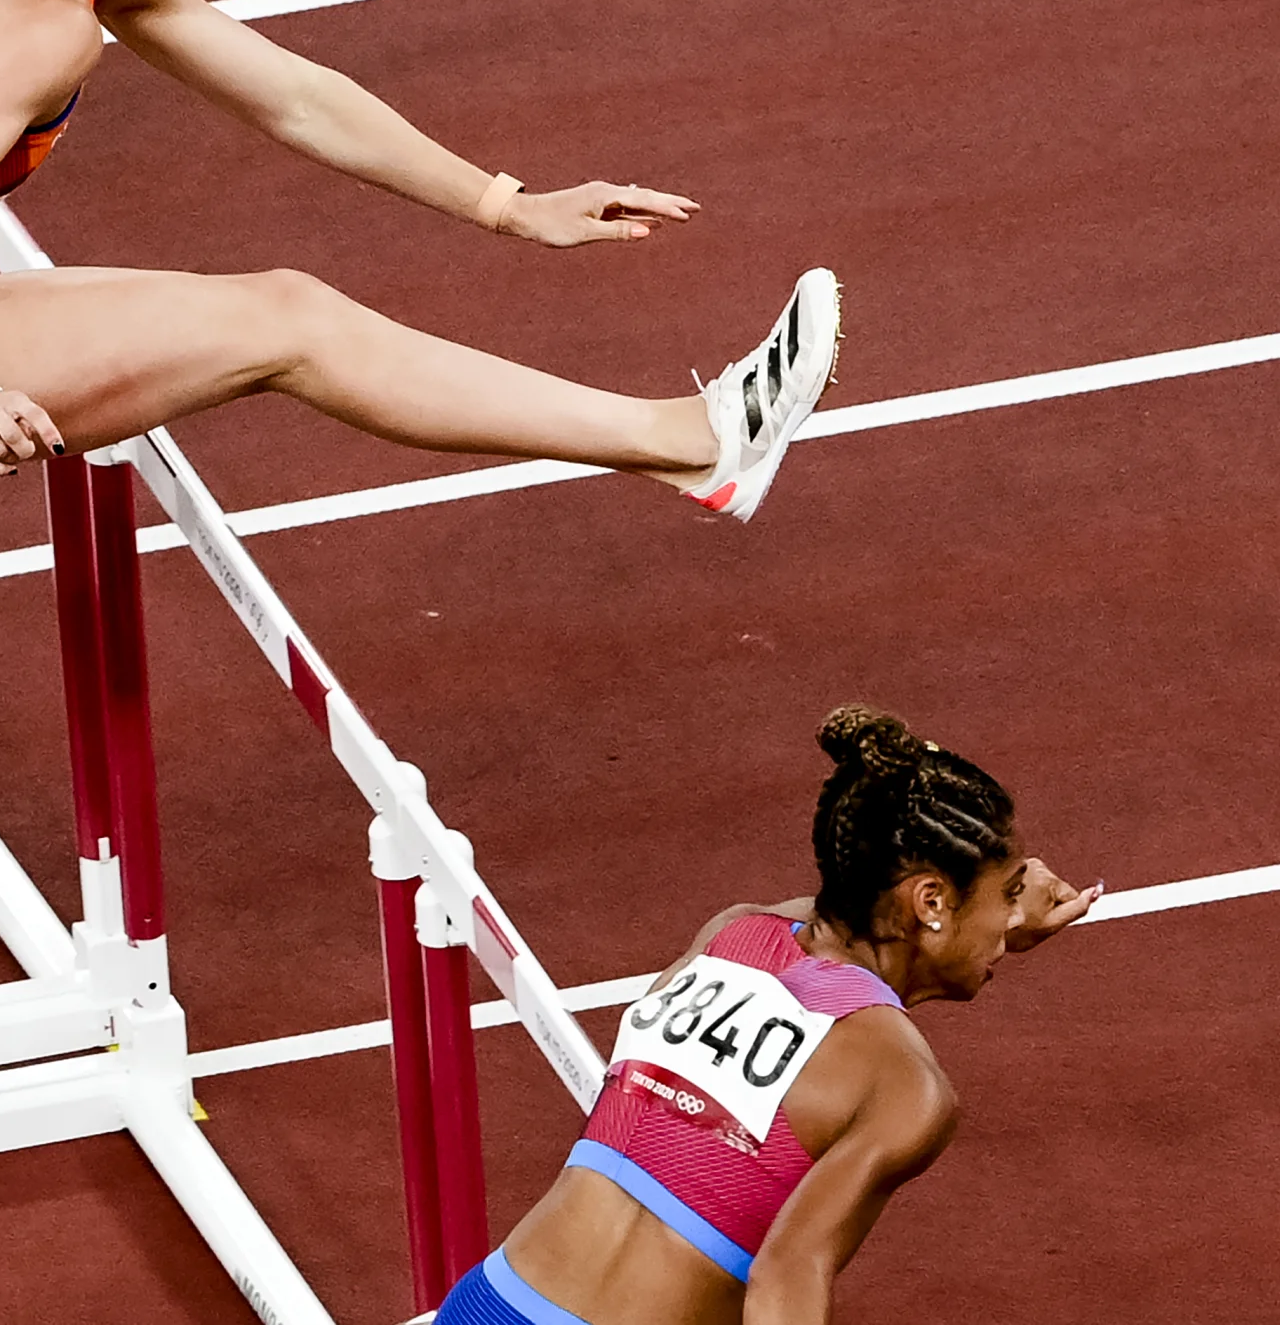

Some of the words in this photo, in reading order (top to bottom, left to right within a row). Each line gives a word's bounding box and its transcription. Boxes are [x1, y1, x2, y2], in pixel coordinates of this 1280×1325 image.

[630, 972, 805, 1088] 3840
[652, 1081, 676, 1101] 2020
[243, 1276, 284, 1325] MOND
